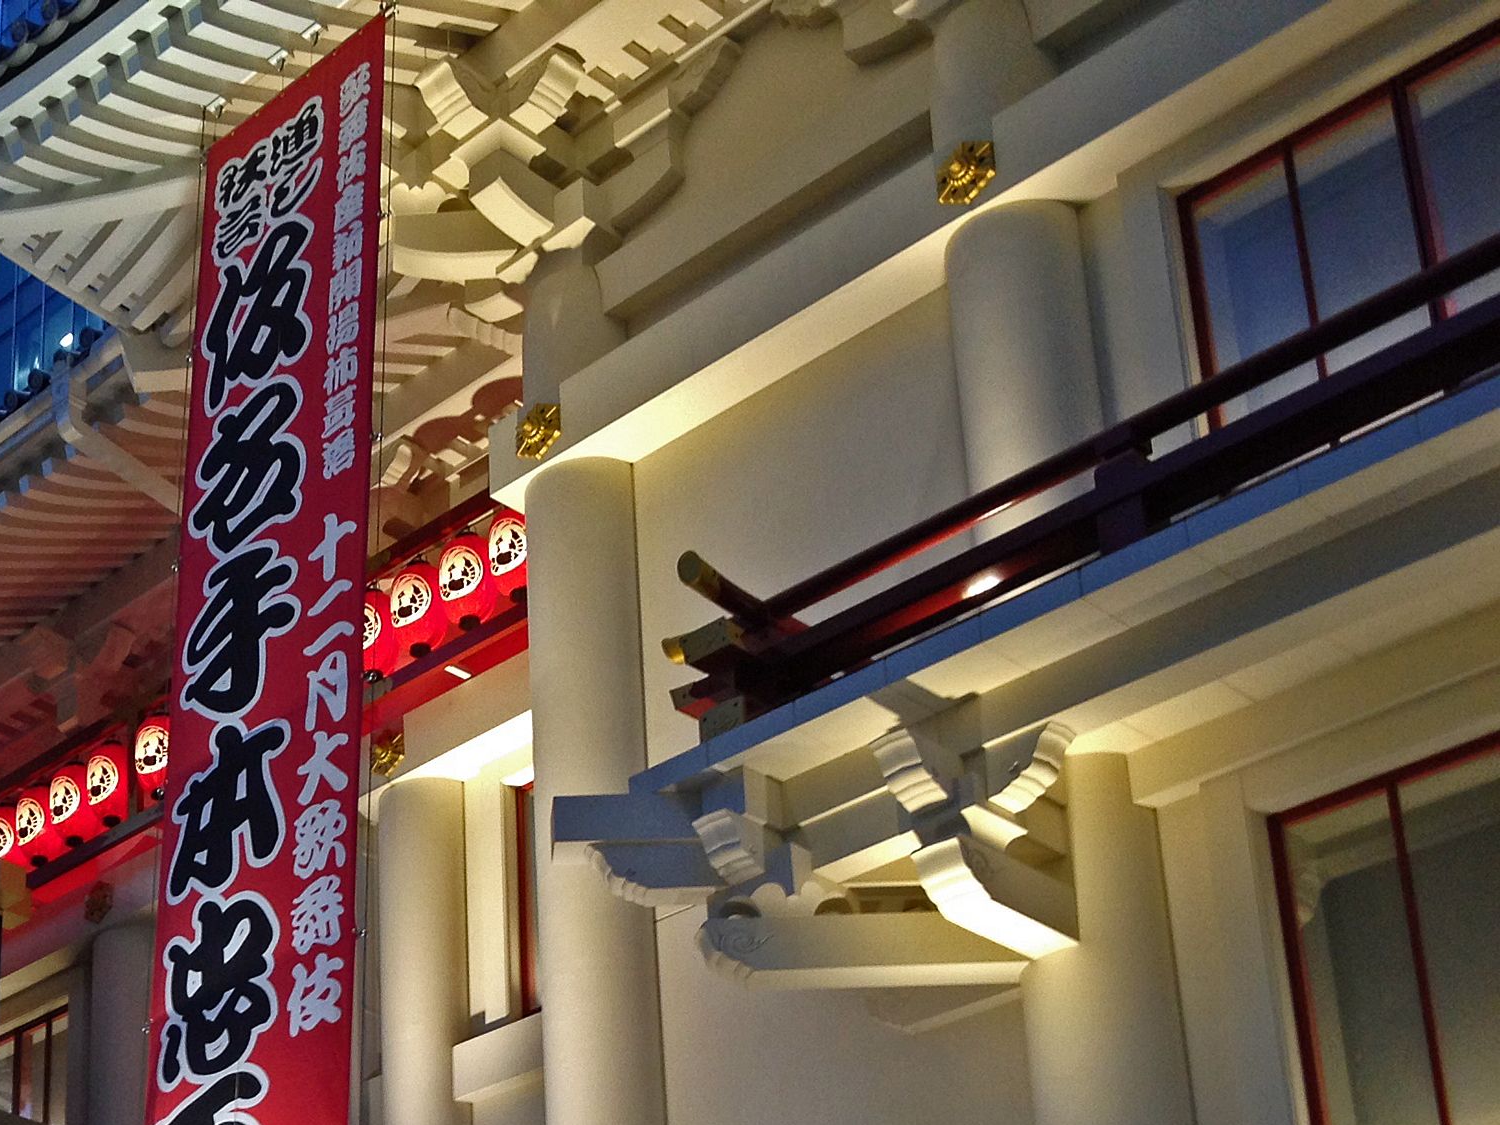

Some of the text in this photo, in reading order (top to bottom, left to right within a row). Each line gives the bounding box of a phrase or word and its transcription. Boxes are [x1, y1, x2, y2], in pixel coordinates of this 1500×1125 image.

[214, 141, 269, 263] 狂言
[269, 98, 322, 220] 通し
[287, 513, 357, 1037] 十二月大歌舞伎
